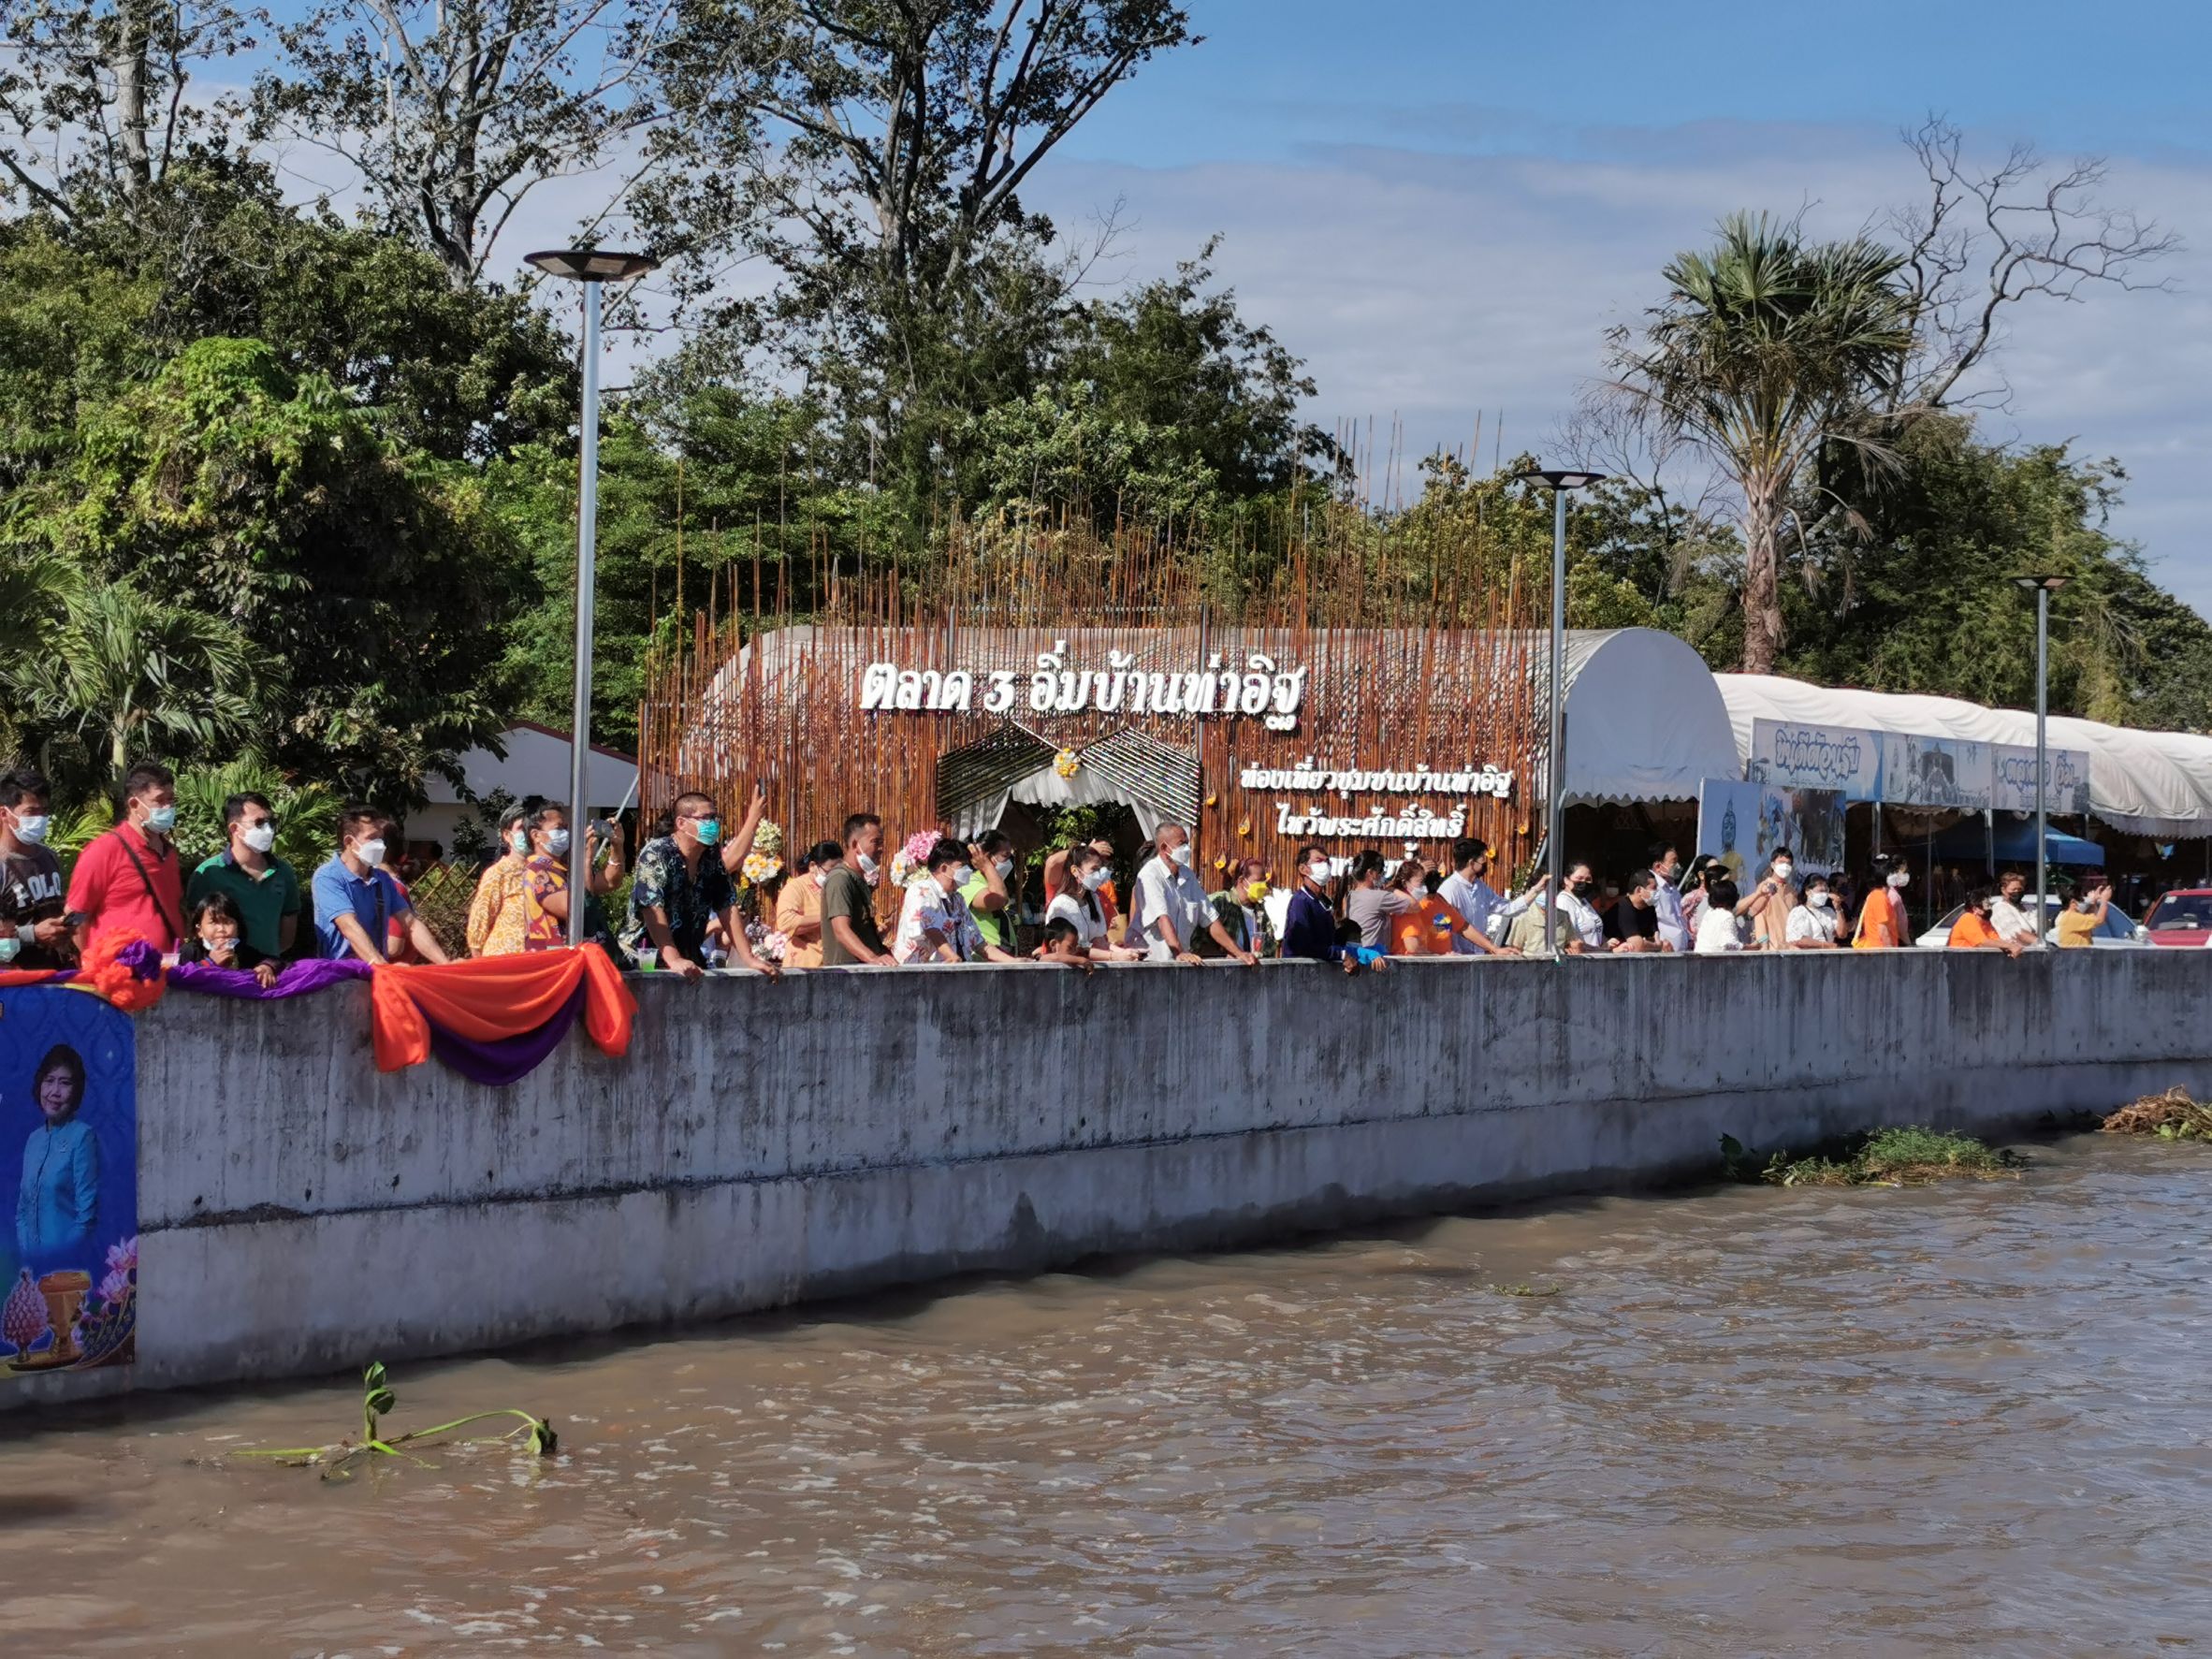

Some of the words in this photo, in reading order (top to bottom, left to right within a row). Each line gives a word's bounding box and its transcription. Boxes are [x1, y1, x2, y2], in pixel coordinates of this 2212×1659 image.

[859, 662, 974, 710] ตลาด
[984, 670, 1017, 712] 3
[1030, 639, 1307, 731] อิ่มบ้านท่าอิฐ
[1241, 755, 1514, 799] ท่องเที่ยวชุมชนบ้านท่าอิฐ
[1276, 802, 1467, 837] ไหว้พระศักดิ์สิทธิ์
